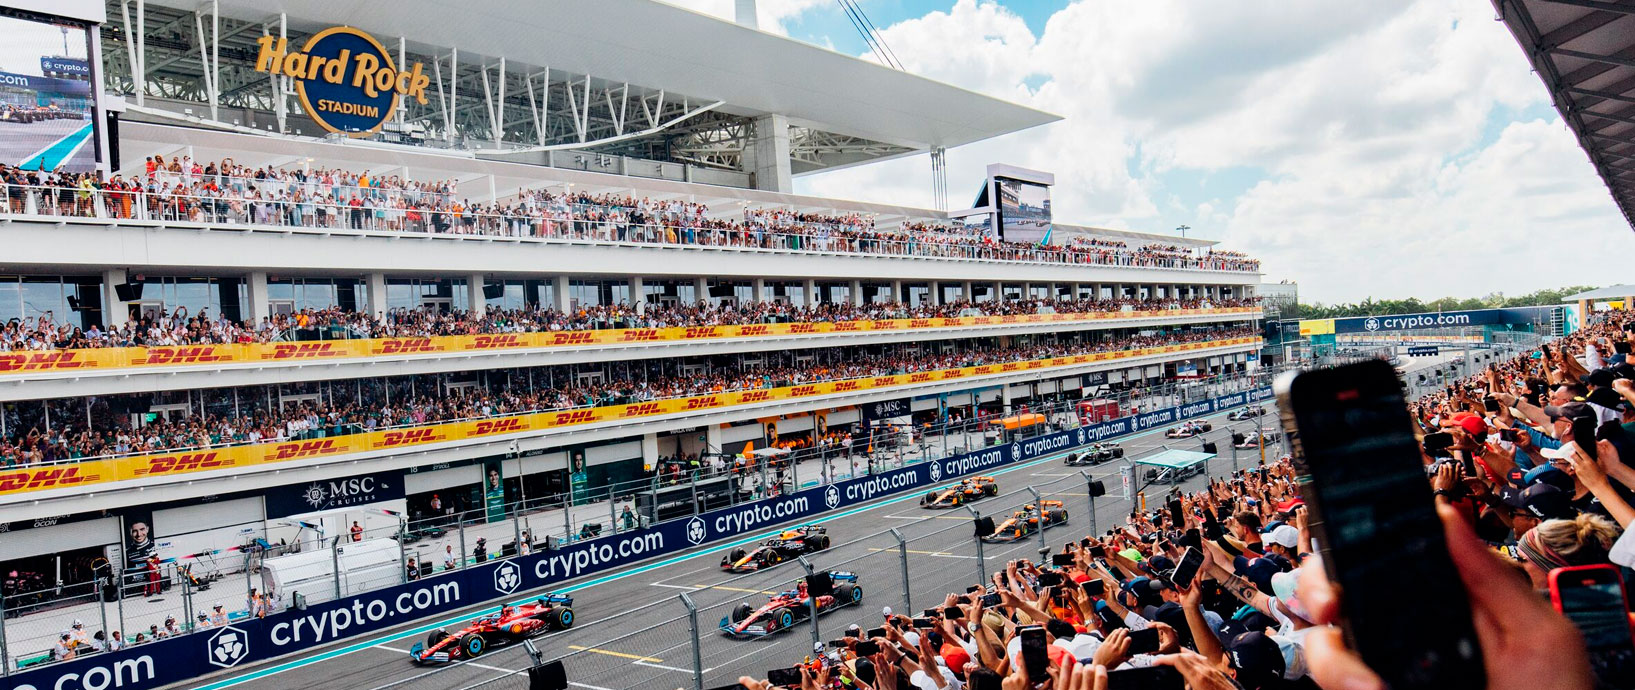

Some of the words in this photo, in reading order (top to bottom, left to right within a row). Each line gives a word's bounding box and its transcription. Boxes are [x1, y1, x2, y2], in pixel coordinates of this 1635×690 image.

[255, 35, 350, 85] Hard
[352, 52, 430, 105] Rock
[318, 98, 379, 119] STADIUM
[834, 321, 858, 332] DHL
[873, 320, 895, 330] DHL
[911, 319, 930, 328] DHL
[1384, 313, 1470, 328] crypto.com
[624, 329, 660, 342] DHL
[685, 327, 718, 339] DHL
[741, 325, 769, 336] DHL
[790, 324, 816, 334] DHL
[382, 339, 435, 354] DHL
[474, 336, 521, 349] DHL
[554, 332, 595, 346] DHL
[146, 347, 220, 366] DHL
[274, 343, 337, 360] DHL
[875, 377, 896, 387] DHL
[911, 373, 930, 383] DHL
[944, 370, 962, 379] DHL
[791, 386, 816, 396] DHL
[835, 381, 858, 391] DHL
[687, 396, 718, 409] DHL
[742, 391, 770, 403] DHL
[1220, 393, 1243, 408] crypto.com
[626, 403, 661, 417] DHL
[883, 401, 901, 412] MSC
[1182, 401, 1210, 417] crypto.com
[556, 410, 596, 425] DHL
[1139, 410, 1171, 427] crypto.com
[476, 418, 522, 435] DHL
[1088, 421, 1125, 440] crypto.com
[384, 428, 437, 447] DHL
[1024, 433, 1070, 456] crypto.com
[276, 440, 338, 460] DHL
[149, 452, 221, 473] DHL
[946, 449, 1002, 475] crypto.com
[329, 477, 375, 498] MSC
[847, 469, 918, 501] crypto.com
[330, 495, 376, 506] CRUISES
[716, 495, 809, 533] crypto.com
[34, 519, 58, 528] OCON
[535, 531, 664, 579] crypto.com
[271, 579, 460, 645] crypto.com
